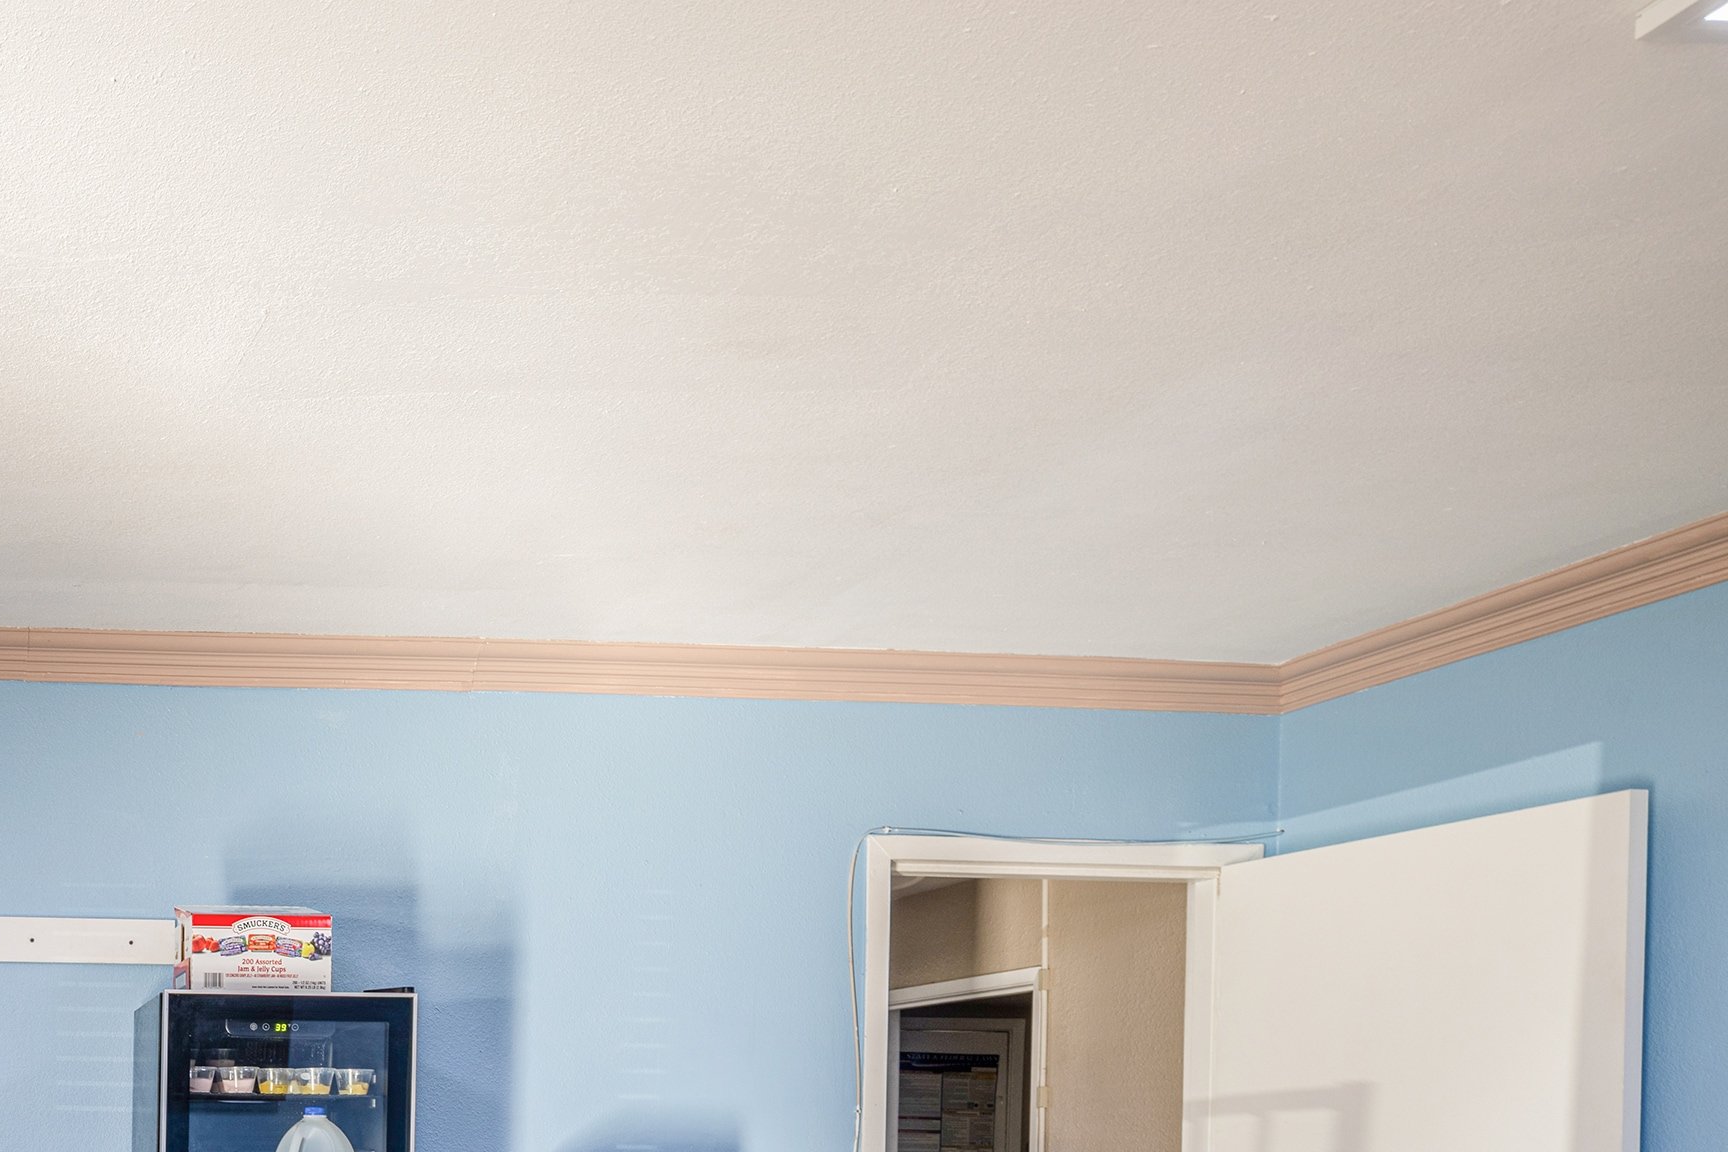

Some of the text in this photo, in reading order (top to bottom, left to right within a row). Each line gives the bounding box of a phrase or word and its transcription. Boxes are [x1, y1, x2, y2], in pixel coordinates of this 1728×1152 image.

[237, 919, 286, 932] SMUCKER'S
[256, 965, 270, 973] Jelly
[271, 965, 287, 973] Cups
[275, 1023, 287, 1032] 39
